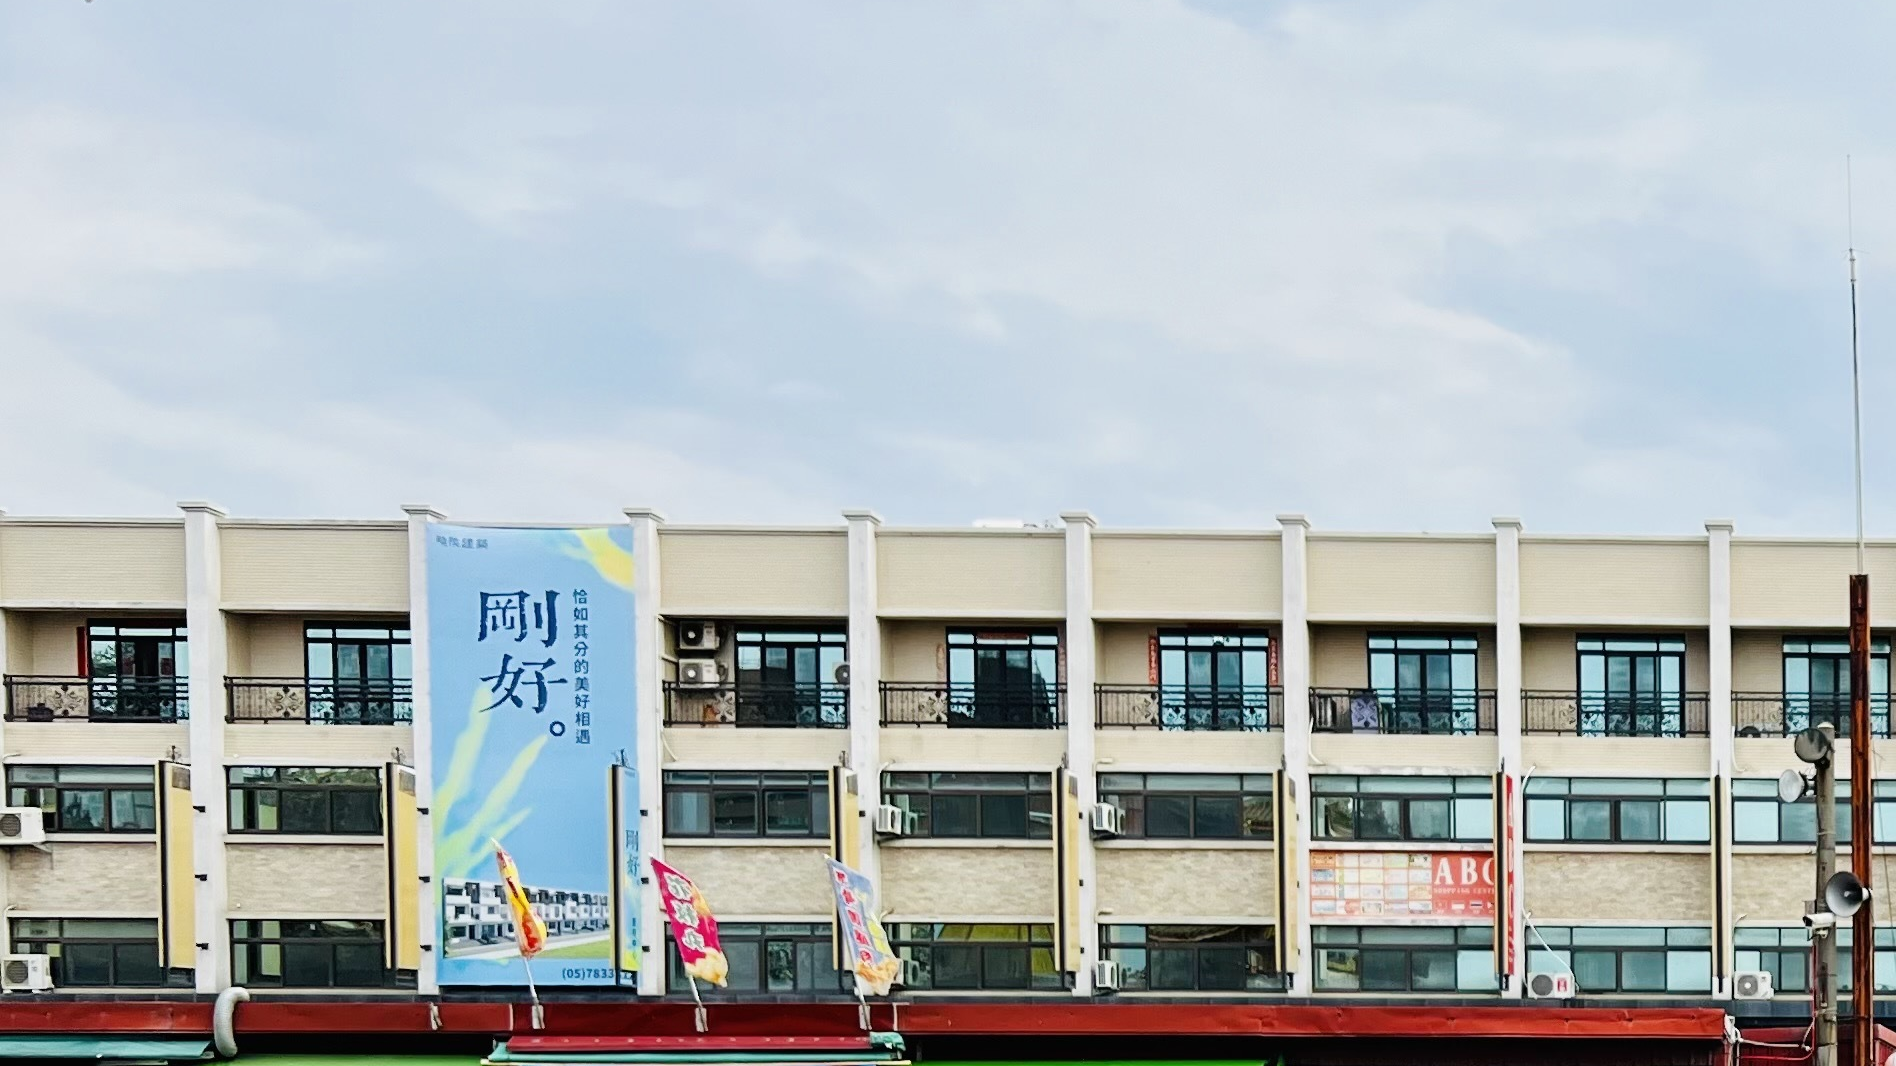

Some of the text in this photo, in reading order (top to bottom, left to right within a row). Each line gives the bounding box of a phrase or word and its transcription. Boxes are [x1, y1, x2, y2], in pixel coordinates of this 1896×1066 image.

[572, 588, 591, 745] 恰如其分的美好相遇
